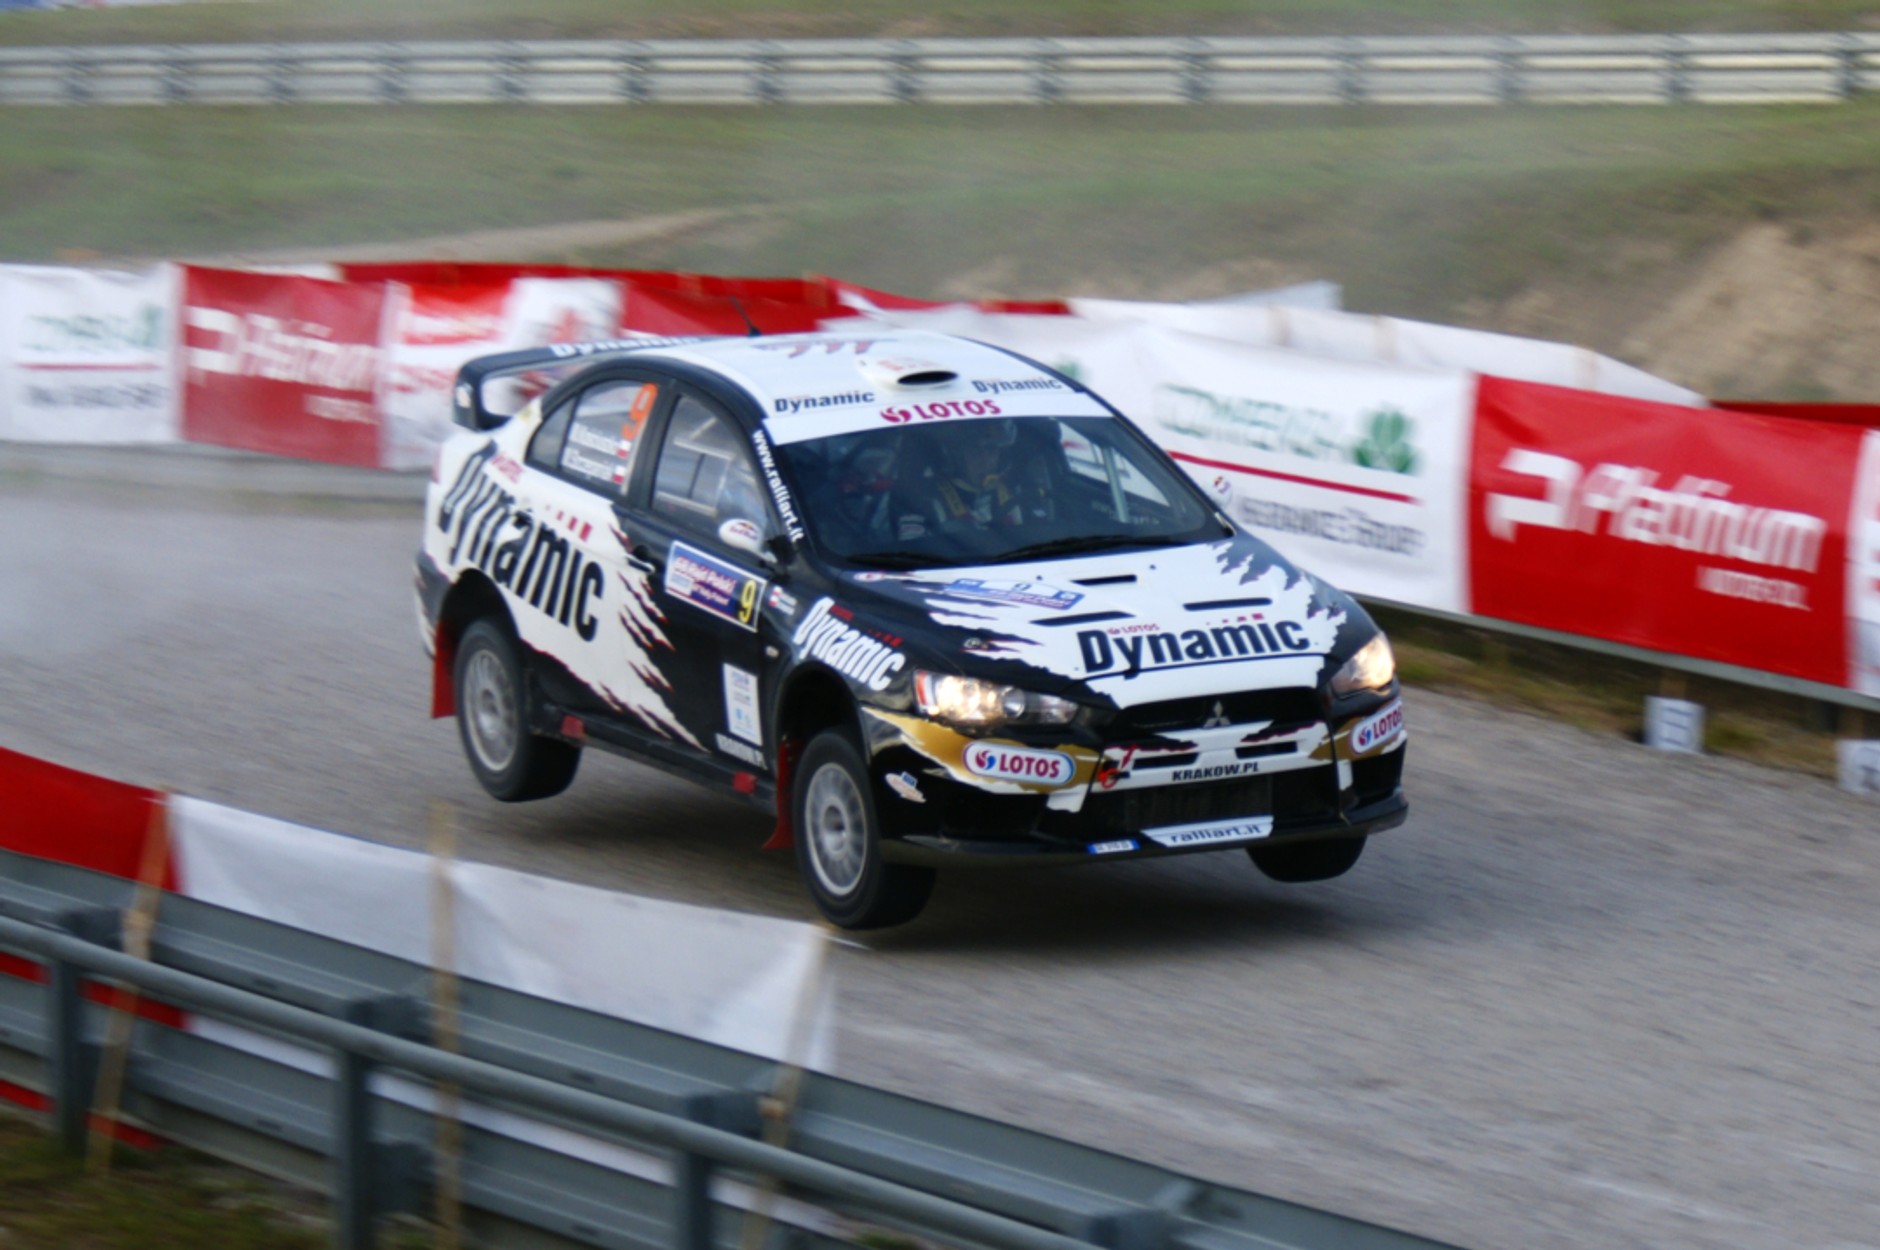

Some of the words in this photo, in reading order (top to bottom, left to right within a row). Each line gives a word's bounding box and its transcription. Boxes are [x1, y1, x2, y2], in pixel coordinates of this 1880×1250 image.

[971, 376, 1063, 394] Dynamic
[623, 382, 659, 443] 9
[774, 390, 876, 414] Dynamic
[913, 399, 1002, 420] LOTOS
[752, 428, 806, 543] www.ralliart.it
[438, 440, 605, 642] Dynamic
[739, 579, 757, 624] 9
[1122, 623, 1160, 634] LOTOS
[792, 596, 907, 692] Dynamic
[1076, 620, 1311, 679] Dynamic
[999, 753, 1061, 778] LOTOS
[1172, 762, 1260, 782] KRAKOW.PL
[1170, 823, 1263, 843] ralliart.it
